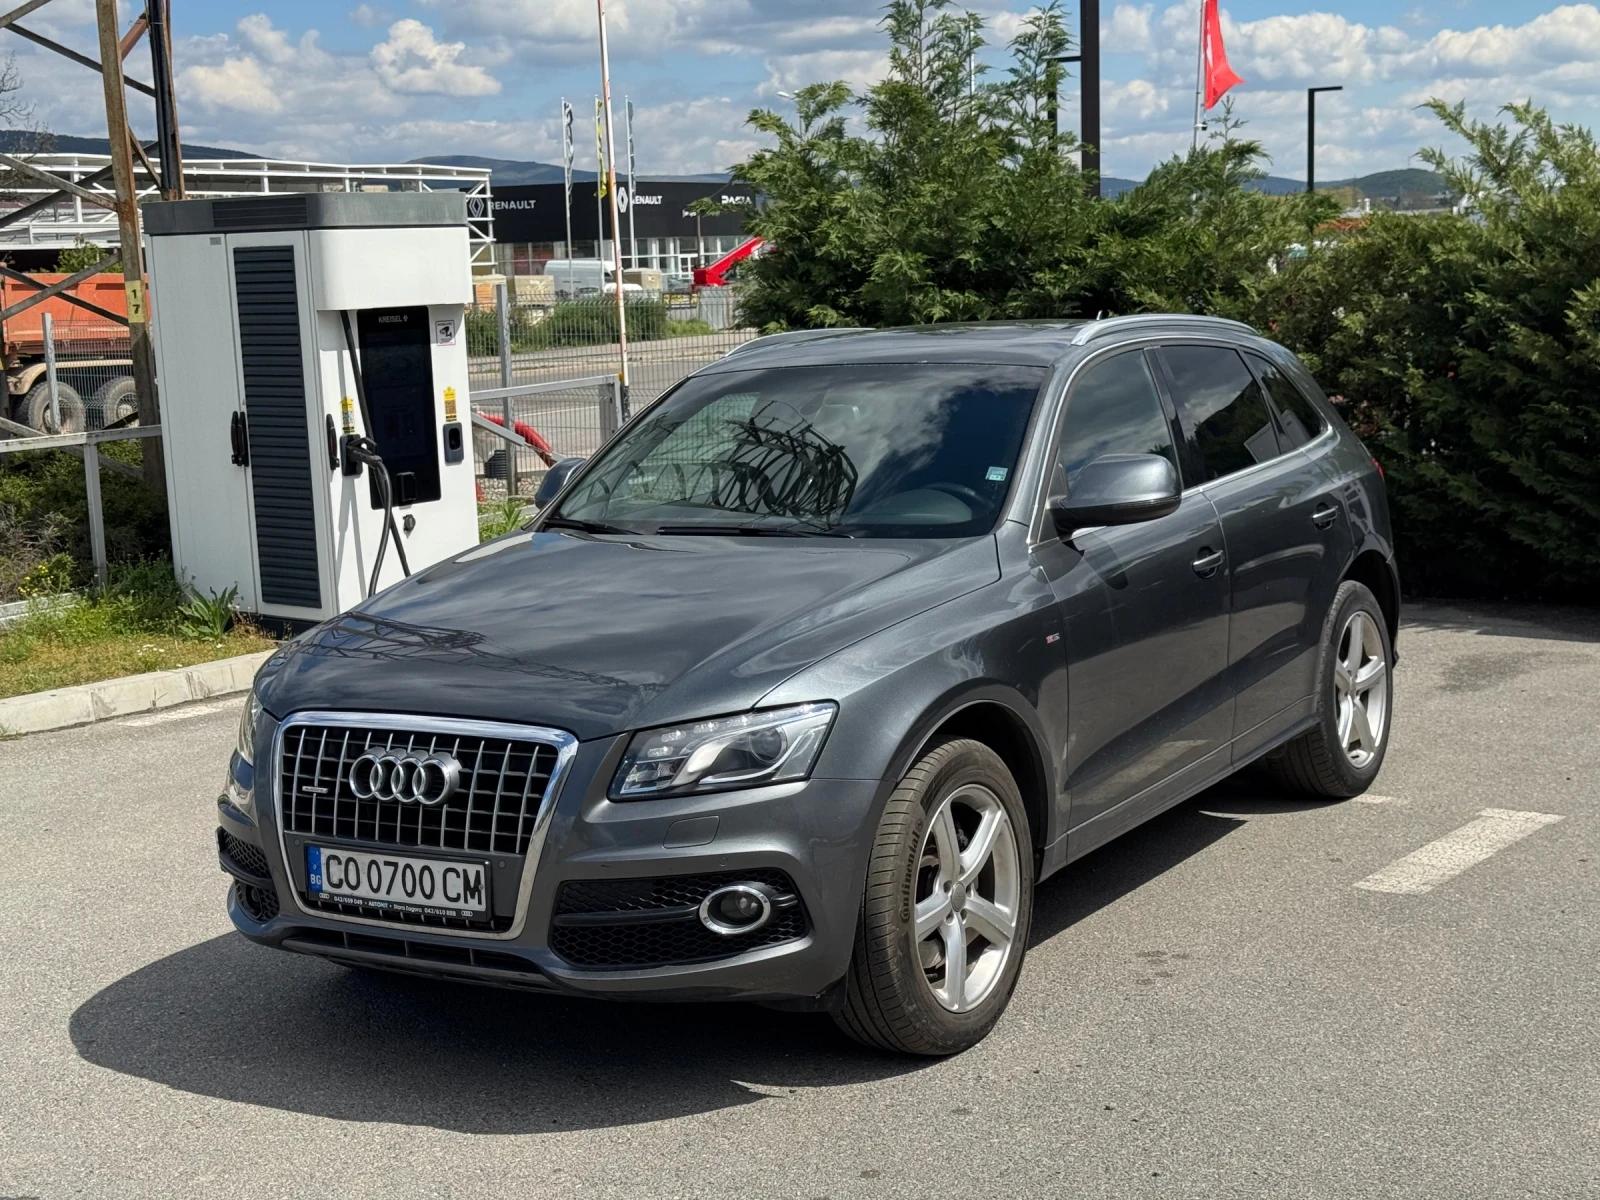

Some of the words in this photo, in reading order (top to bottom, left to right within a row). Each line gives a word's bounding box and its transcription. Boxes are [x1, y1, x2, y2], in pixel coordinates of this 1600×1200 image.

[489, 200, 537, 210] RENAULT
[378, 315, 402, 323] KREISEL
[310, 873, 322, 885] BG
[901, 831, 921, 923] Continental
